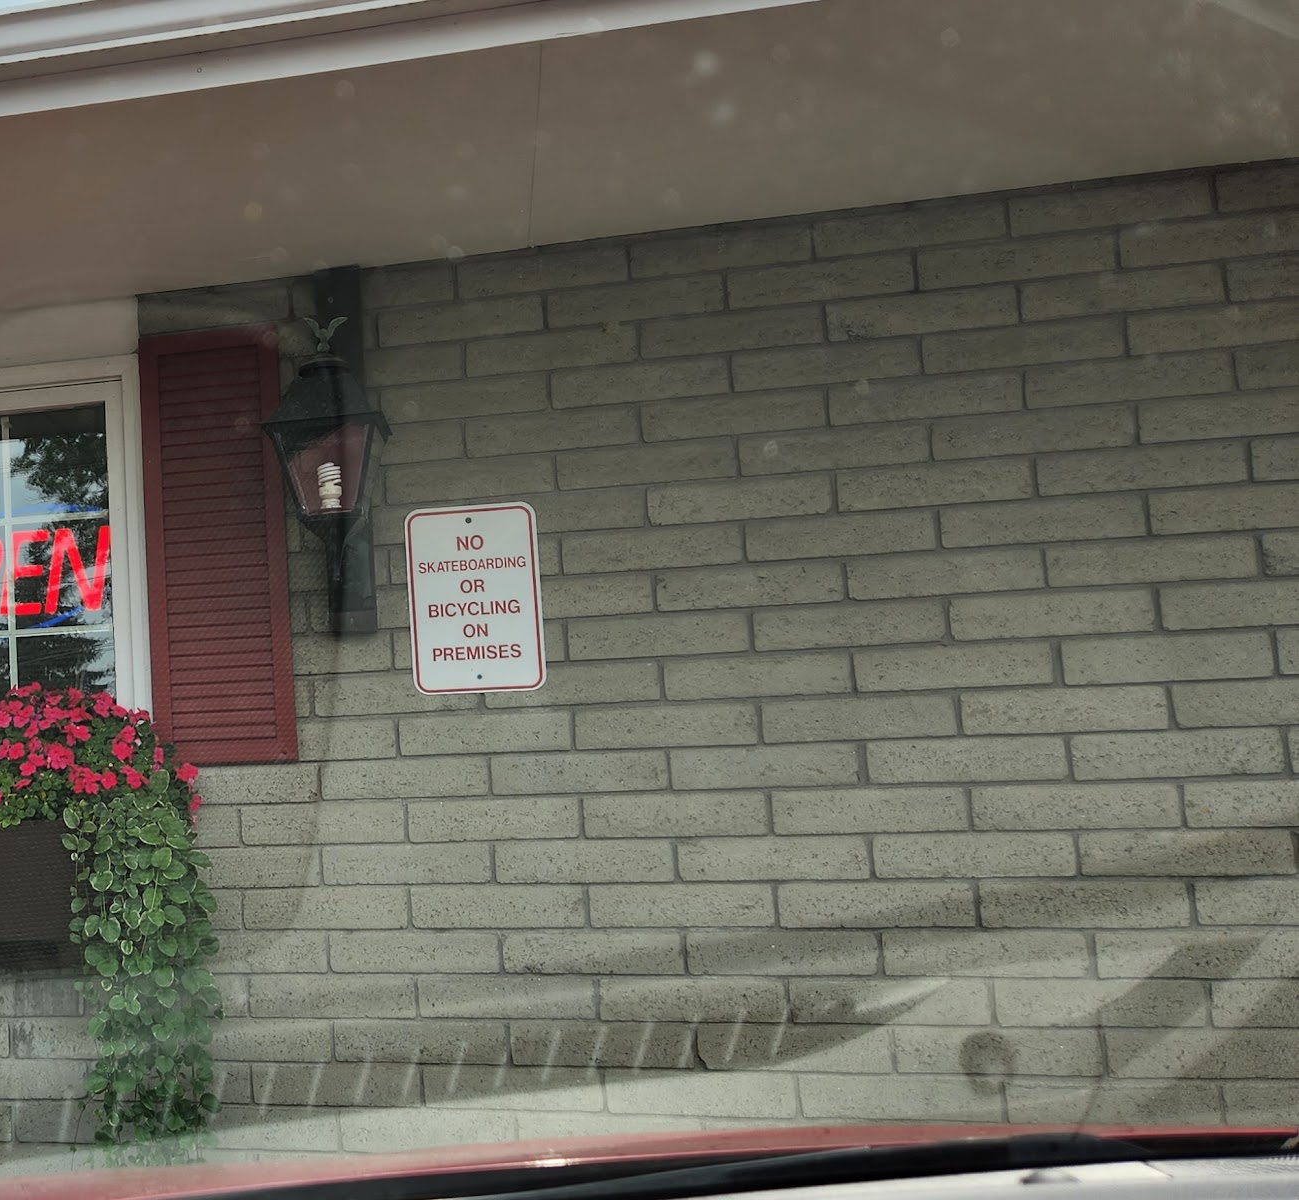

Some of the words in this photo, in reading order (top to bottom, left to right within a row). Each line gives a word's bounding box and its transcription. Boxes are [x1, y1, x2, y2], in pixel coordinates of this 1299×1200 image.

[456, 534, 484, 551] NO
[418, 555, 527, 574] SKATEBOARDING
[459, 579, 486, 593] OR
[427, 599, 521, 618] BICYCLING
[462, 623, 489, 638] ON
[432, 644, 522, 662] PREMISES
